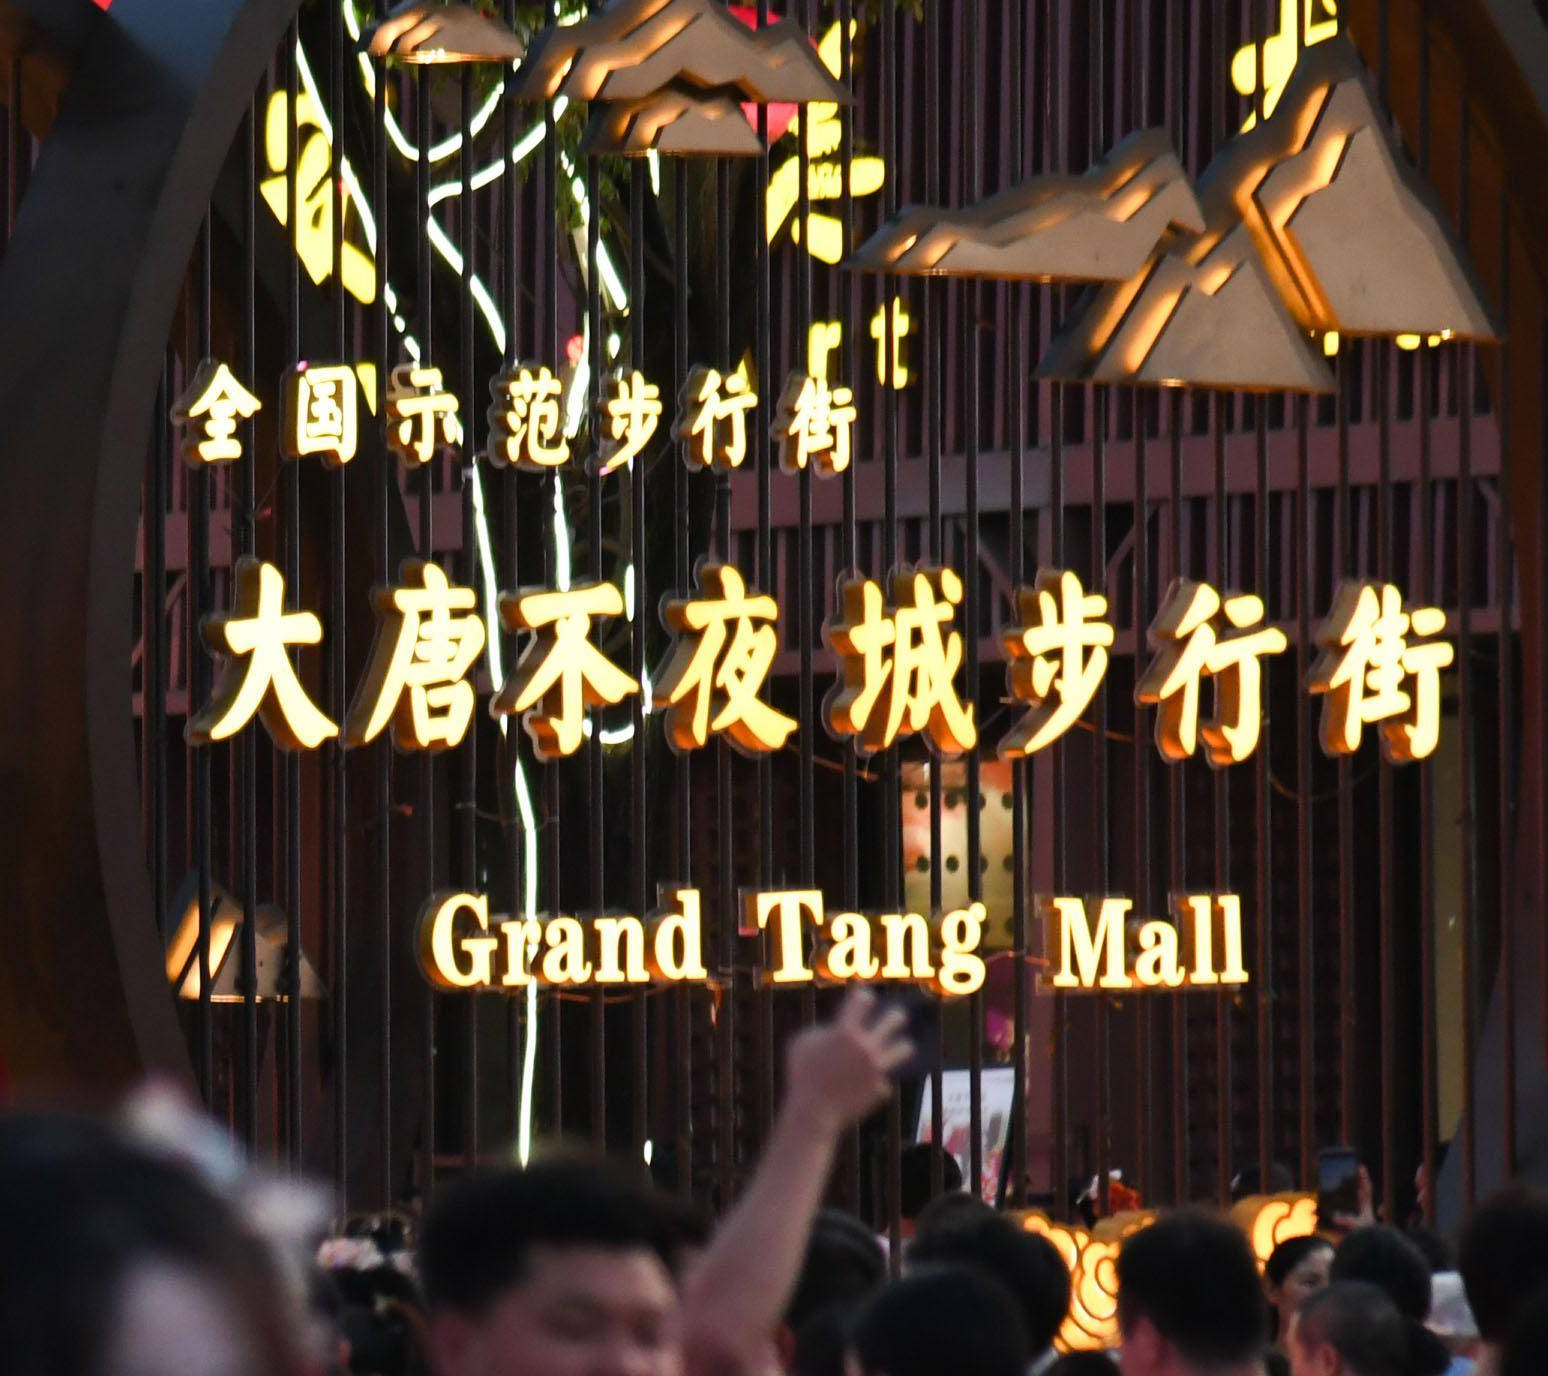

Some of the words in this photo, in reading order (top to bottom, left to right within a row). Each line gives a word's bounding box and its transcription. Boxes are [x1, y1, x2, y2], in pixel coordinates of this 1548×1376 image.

[187, 363, 856, 473] 全国示范步行街
[209, 562, 1454, 760] 大唐不夜城步行街
[431, 889, 708, 986] Grand
[756, 890, 987, 996] Tang
[1053, 895, 1249, 988] Mall
